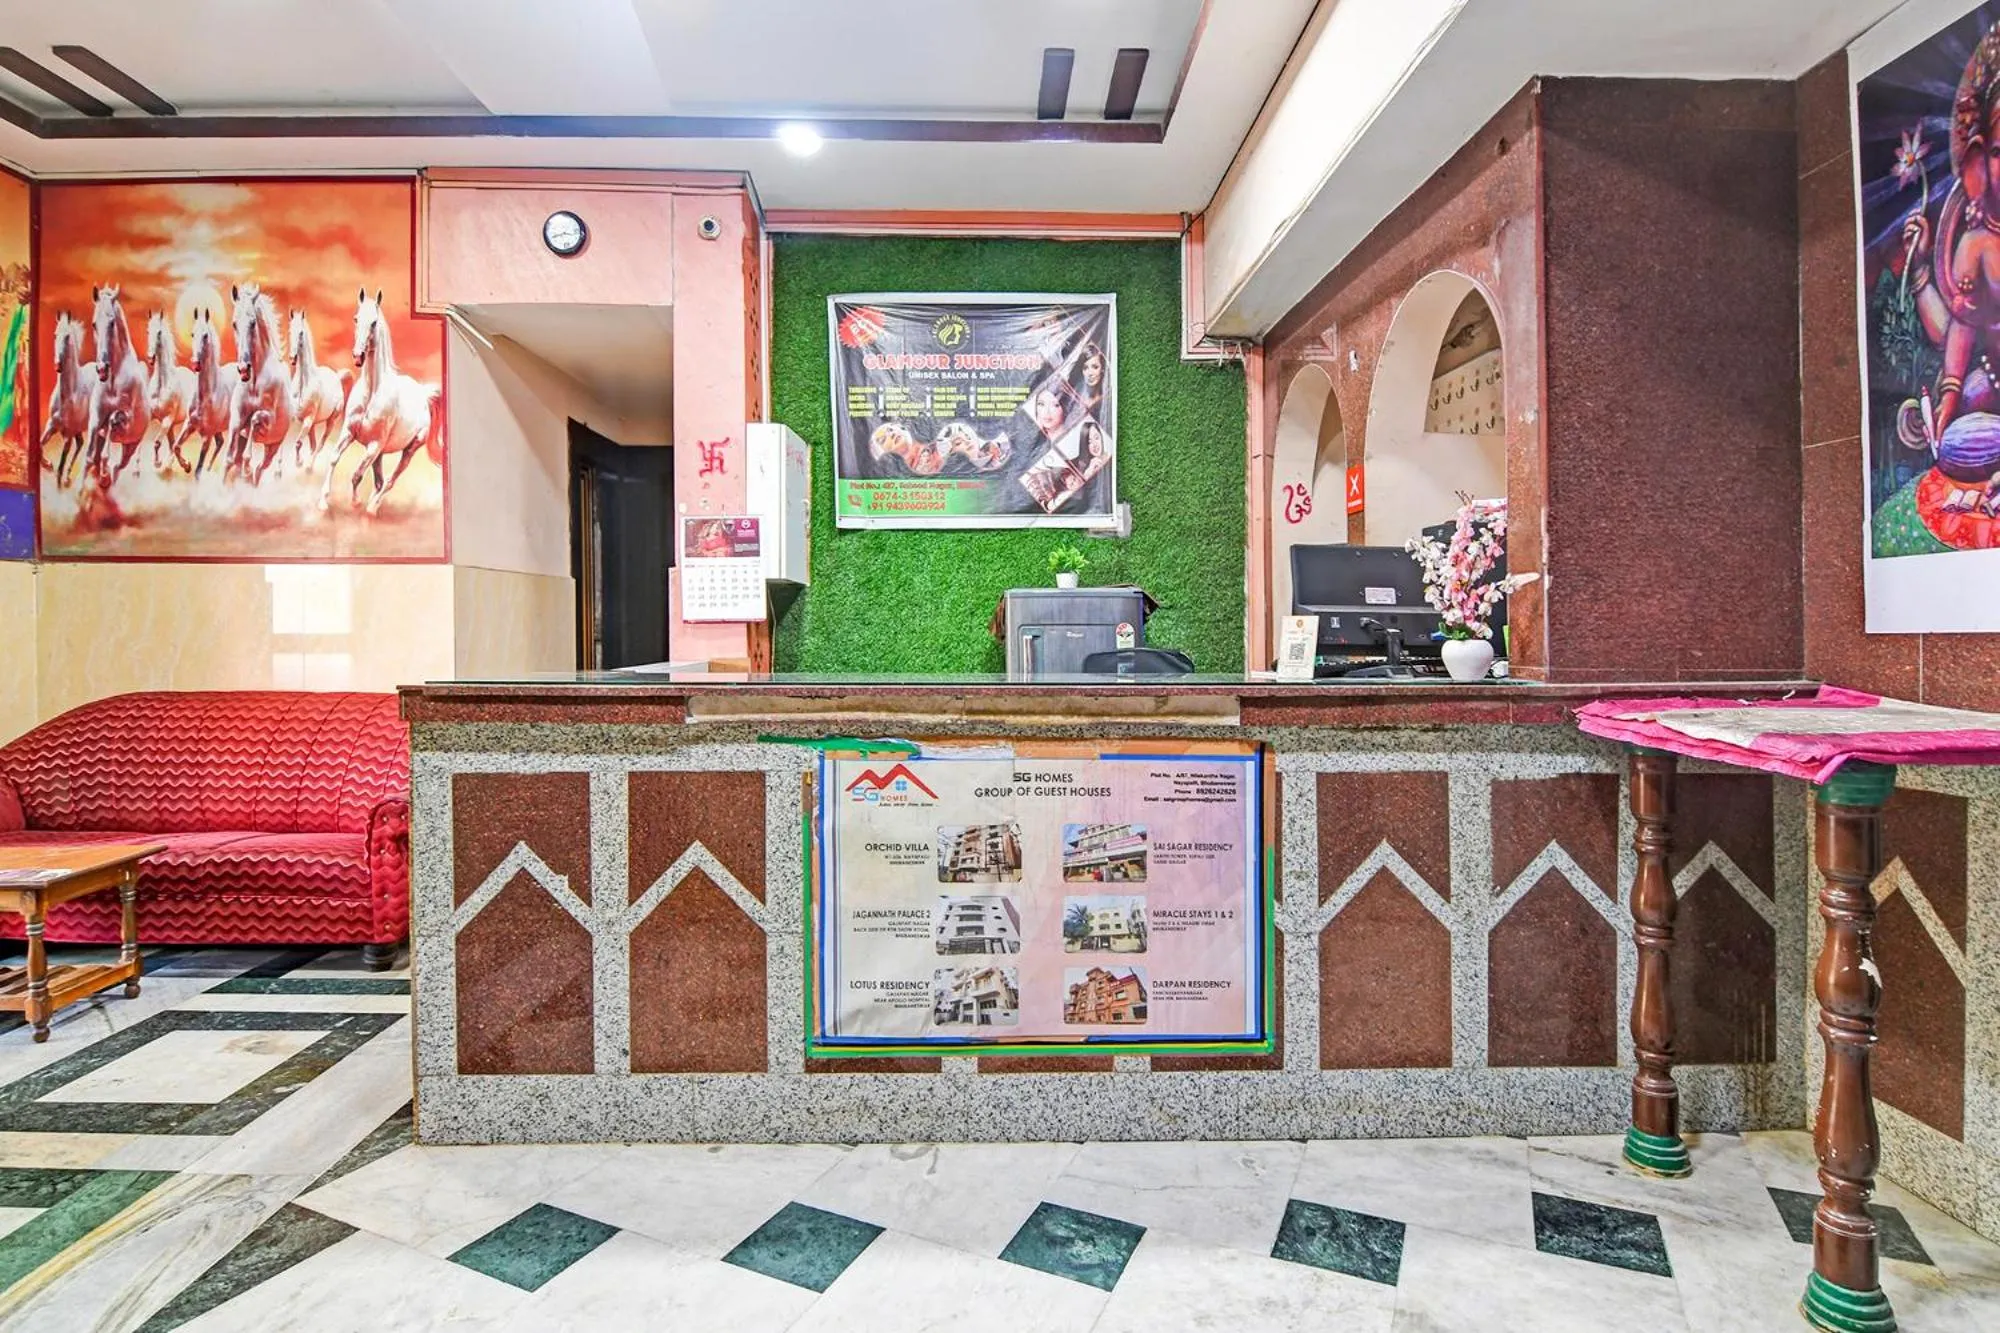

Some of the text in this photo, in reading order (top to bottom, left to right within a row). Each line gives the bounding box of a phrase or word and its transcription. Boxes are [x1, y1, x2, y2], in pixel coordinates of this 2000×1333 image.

[863, 353, 1041, 370] GLAMOUR JUNCTION
[1013, 772, 1073, 783] SG HOMES
[974, 786, 1112, 798] GROUP OF GUEST HOUSES
[864, 843, 929, 851] ORCHID VILLA
[1153, 843, 1233, 851] SAI SAGAR RESIDENCY
[853, 910, 931, 919] JAGANNATH PALACE 2
[1152, 910, 1187, 918] MIRACLE
[1188, 910, 1212, 918] STAYS
[1228, 910, 1234, 918] 2
[850, 980, 930, 990] LOTUS RESIDENCY
[1153, 980, 1232, 989] DARPAN RESIDENCY
